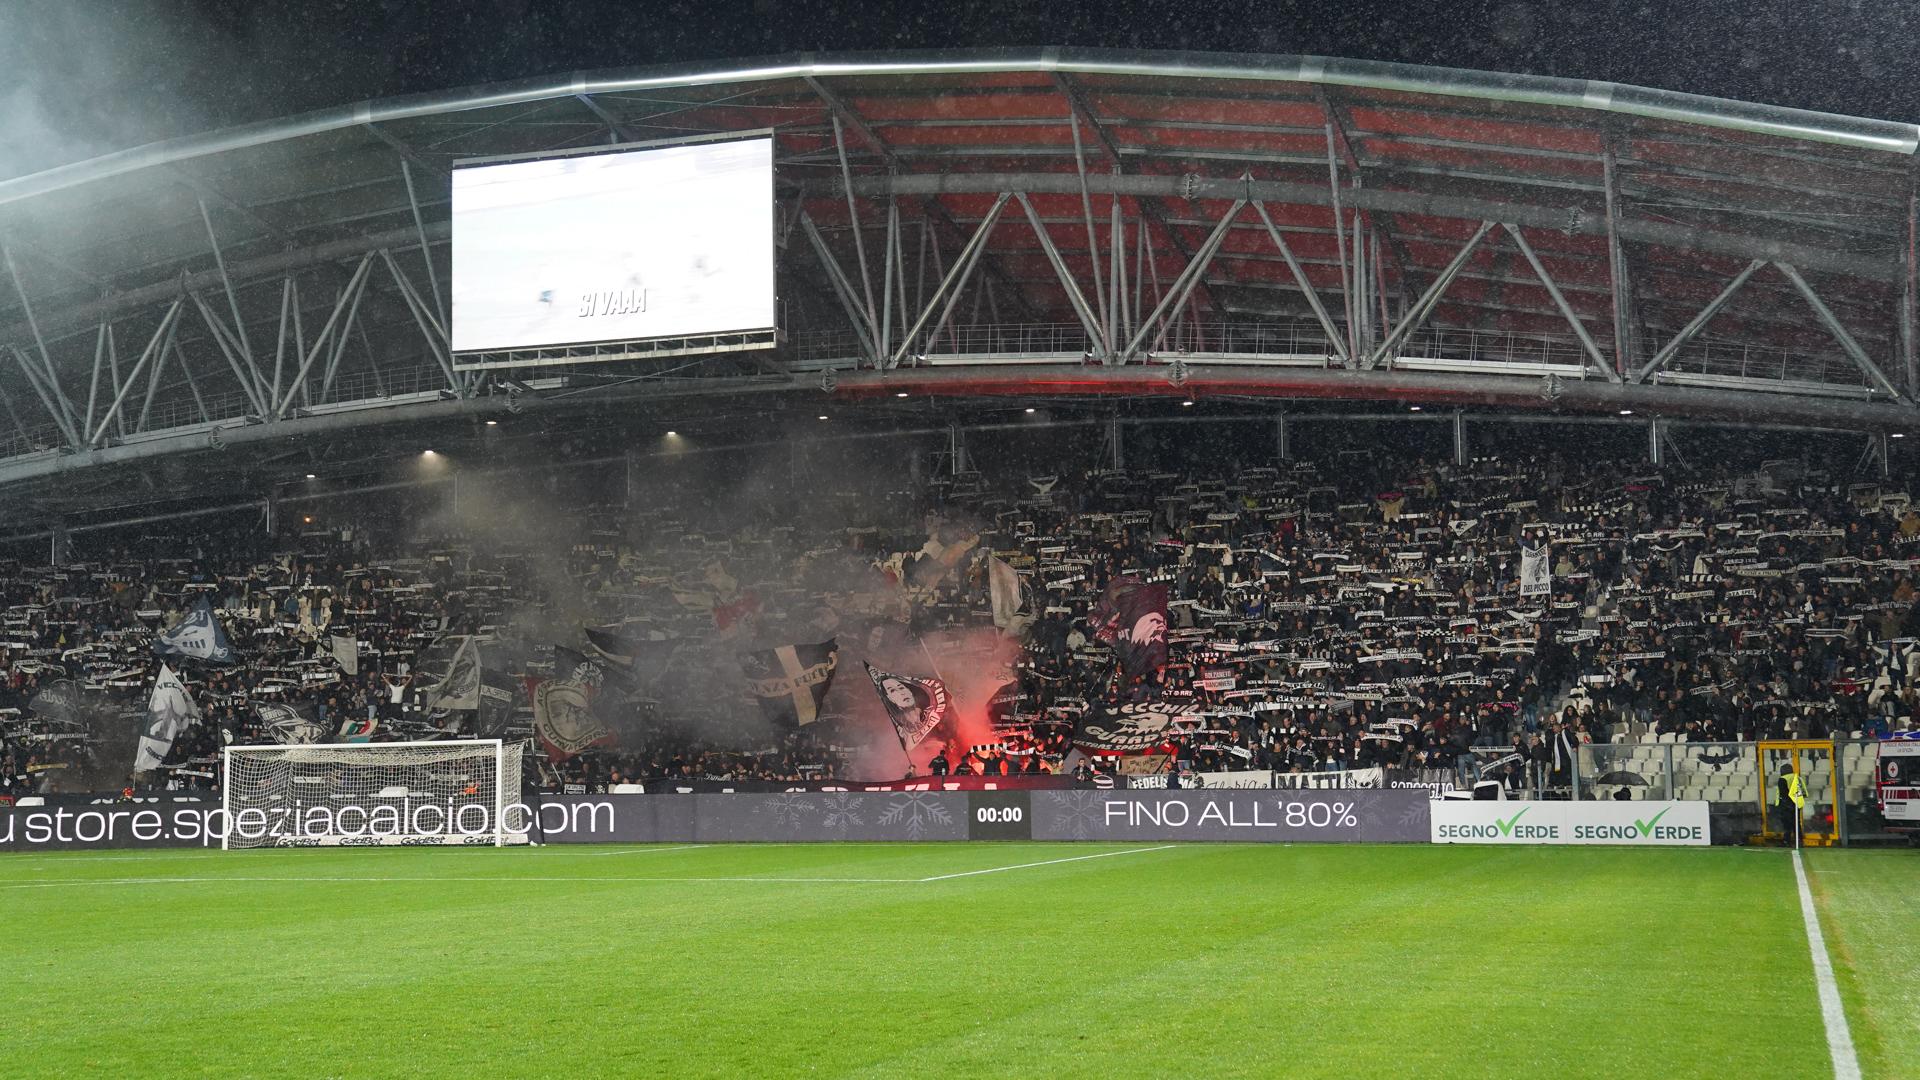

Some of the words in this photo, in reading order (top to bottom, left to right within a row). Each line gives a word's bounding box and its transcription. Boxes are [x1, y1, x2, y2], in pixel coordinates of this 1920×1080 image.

[579, 293, 598, 317] SI
[601, 288, 647, 316] VAAA
[977, 808, 1023, 822] 00:00
[1105, 801, 1190, 827] FINO
[25, 797, 615, 847] store.speziacalcio.com
[278, 837, 321, 847] GoldBet
[339, 836, 383, 846] GoldBet
[401, 835, 446, 845] GoldBet
